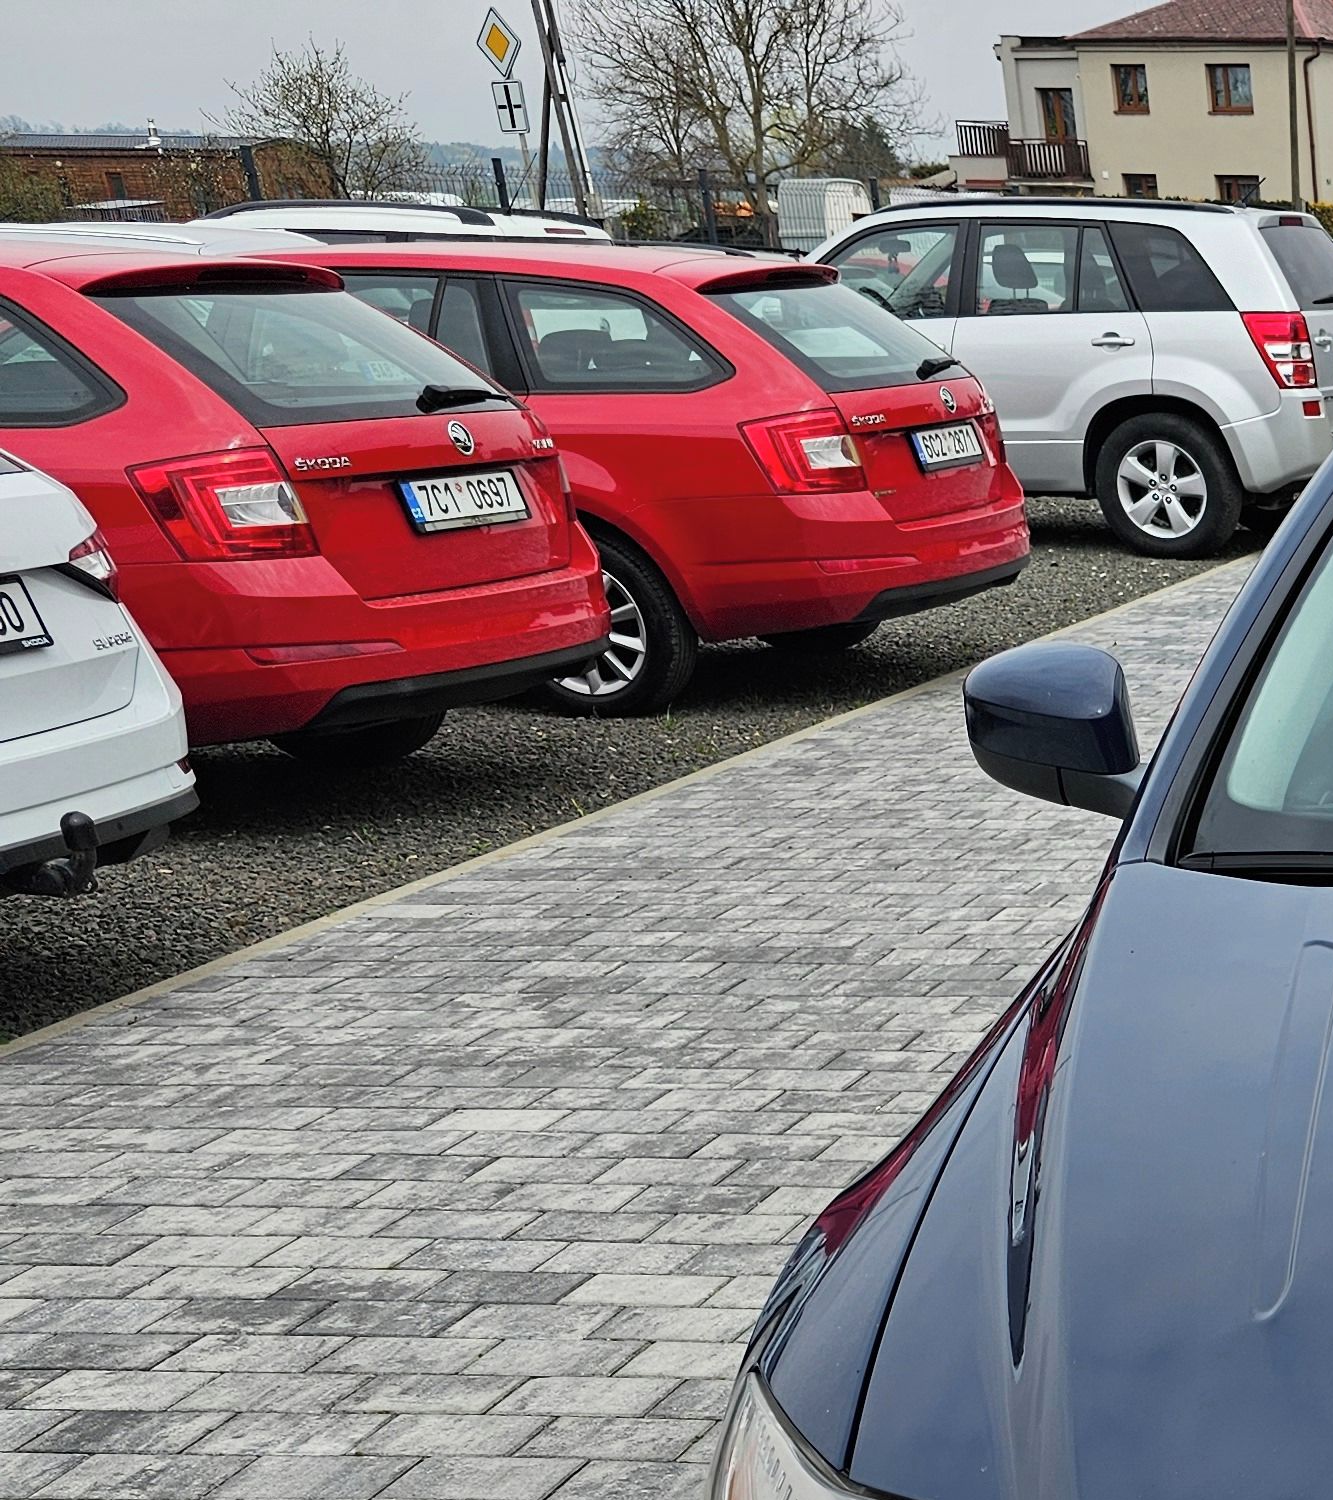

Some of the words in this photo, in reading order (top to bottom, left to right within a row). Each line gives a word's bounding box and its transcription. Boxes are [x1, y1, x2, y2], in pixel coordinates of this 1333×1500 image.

[922, 433, 947, 459] 6C2
[949, 427, 976, 455] 2871
[417, 483, 461, 516] 7C1
[466, 477, 512, 509] 0697
